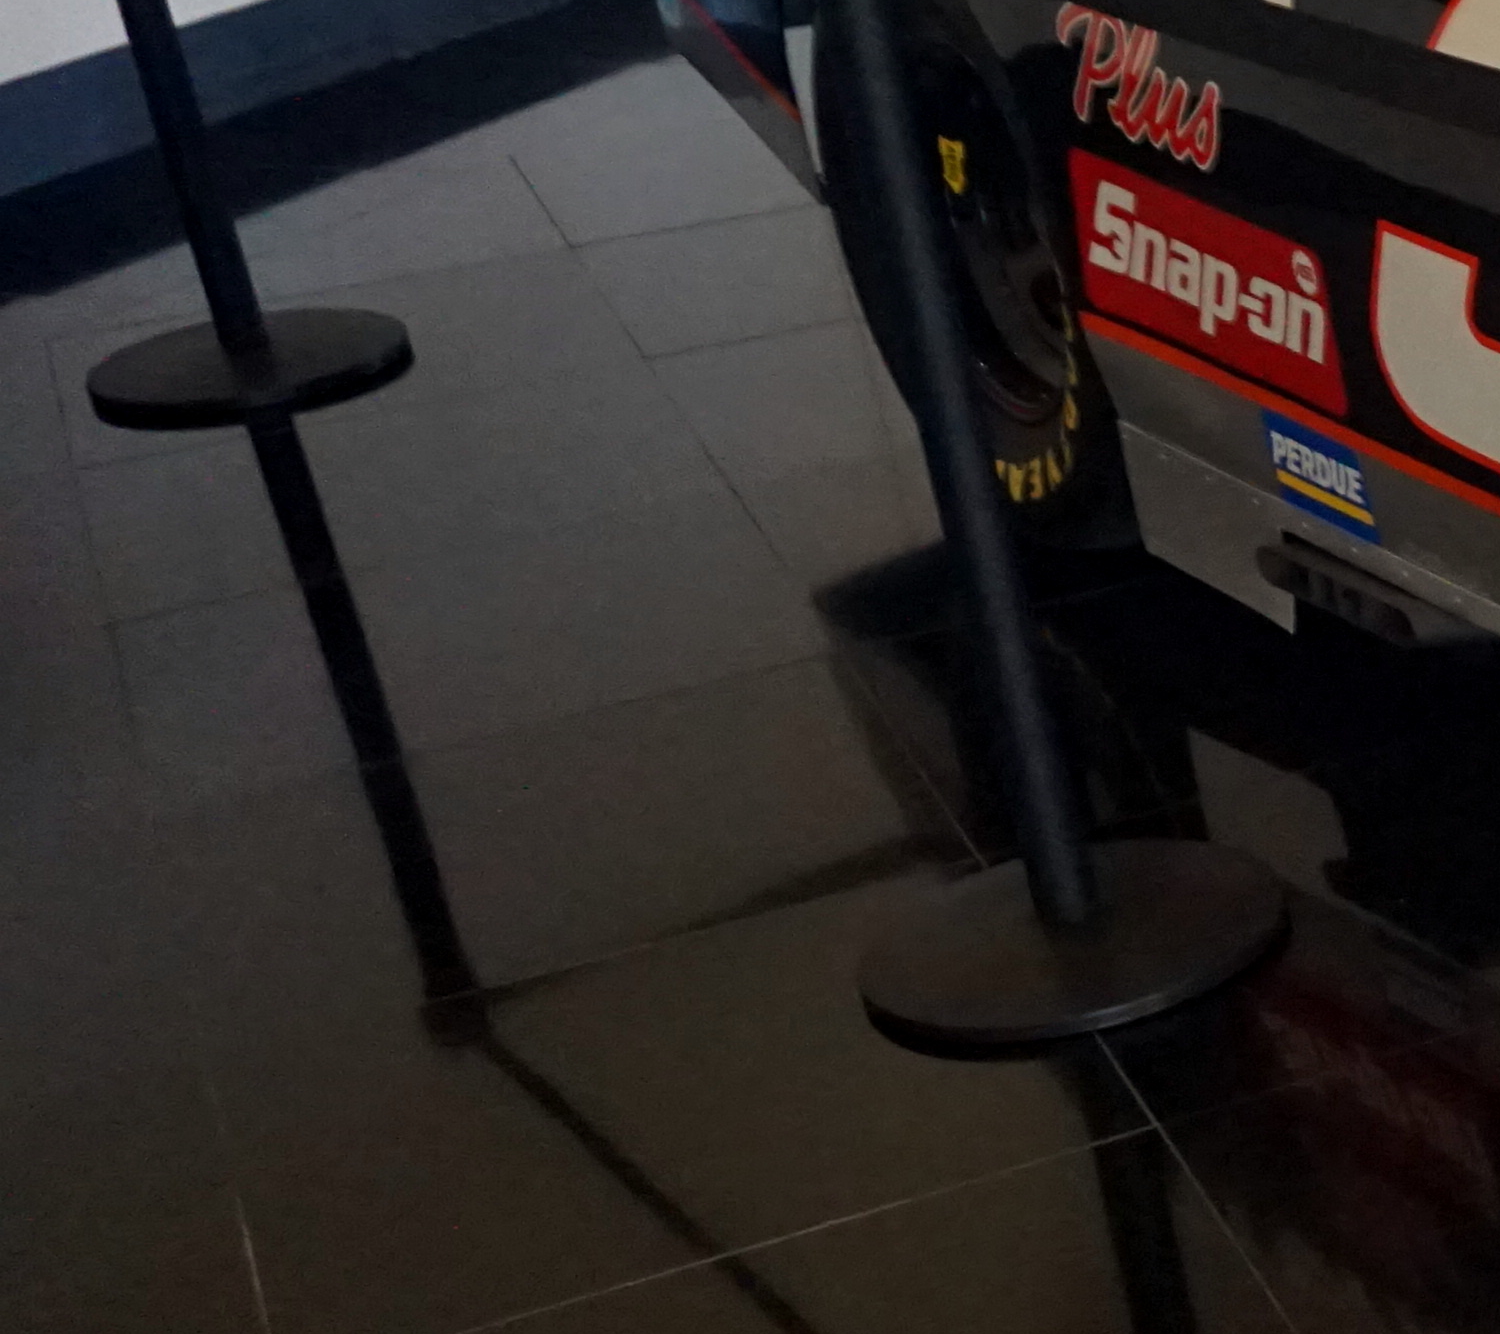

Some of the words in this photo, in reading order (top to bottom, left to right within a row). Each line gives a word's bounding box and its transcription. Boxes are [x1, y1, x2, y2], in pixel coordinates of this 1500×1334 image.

[1056, 1, 1222, 173] Plus
[1088, 179, 1326, 365] Snap-on
[1269, 430, 1367, 506] PERDUE
